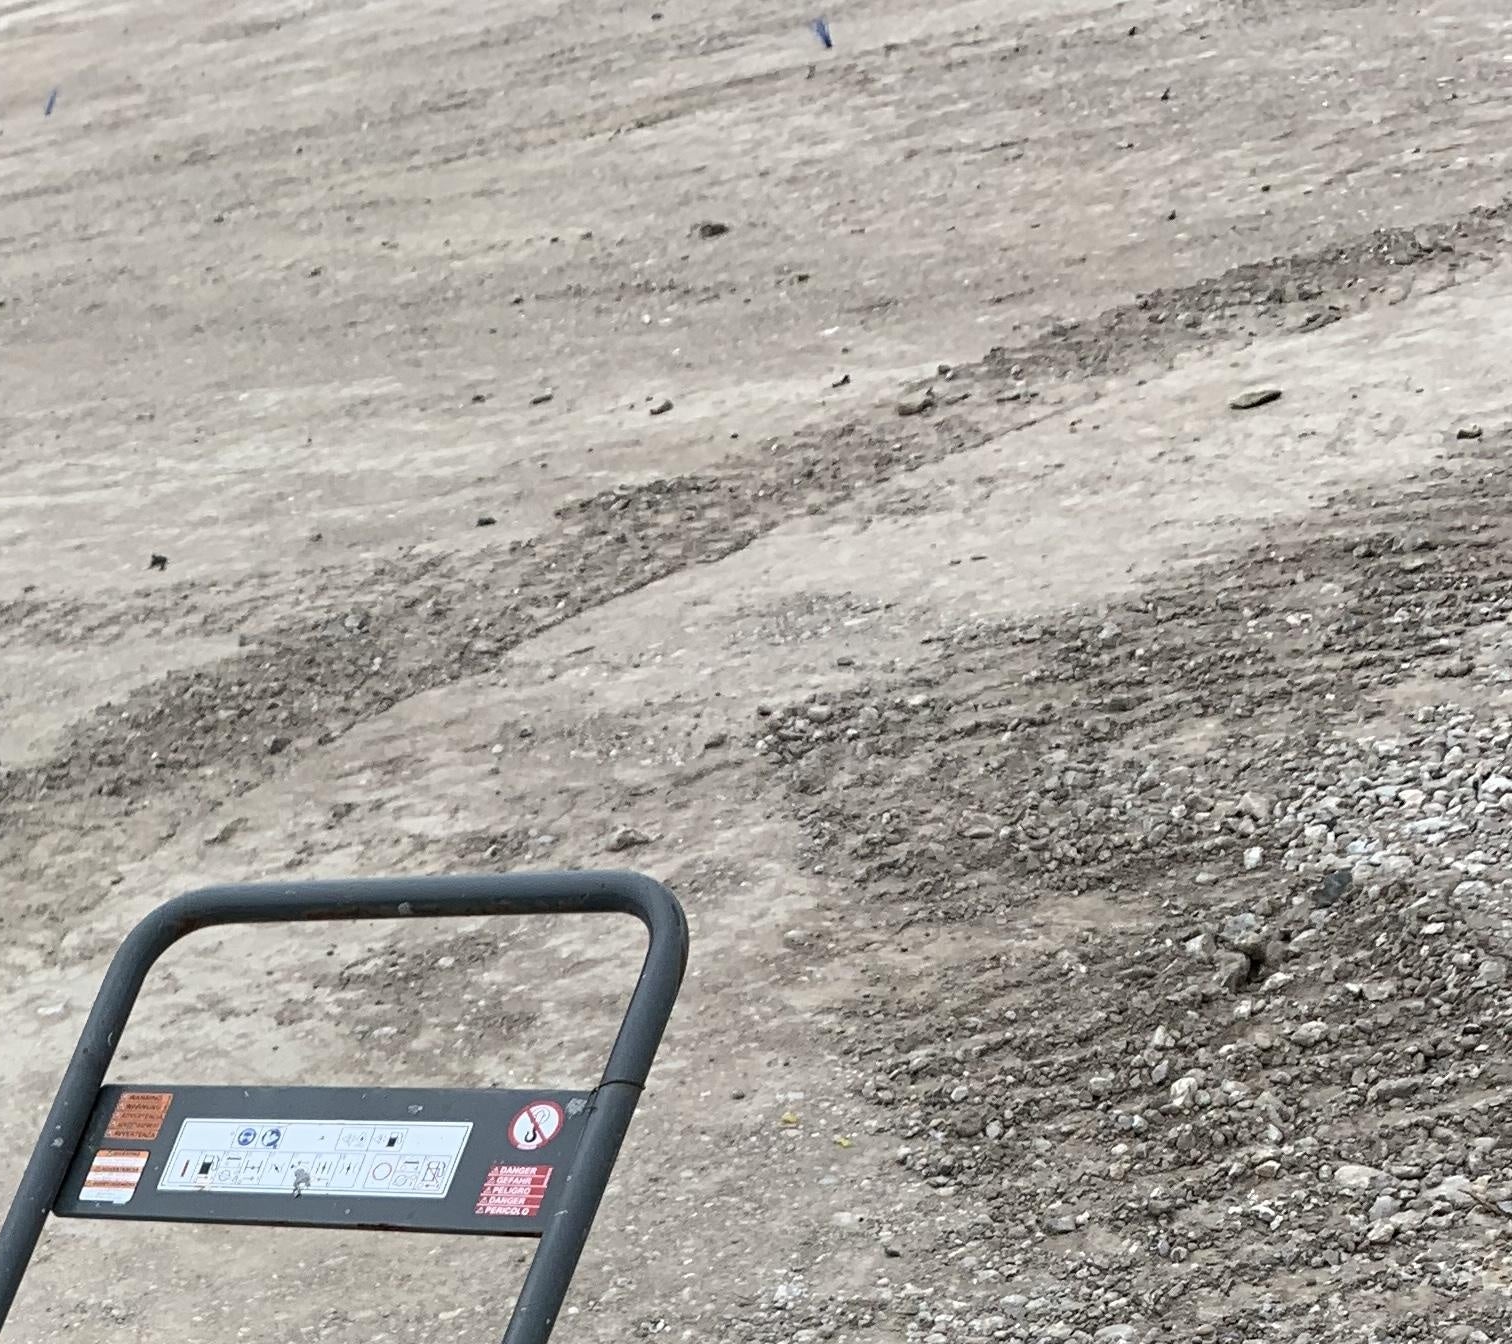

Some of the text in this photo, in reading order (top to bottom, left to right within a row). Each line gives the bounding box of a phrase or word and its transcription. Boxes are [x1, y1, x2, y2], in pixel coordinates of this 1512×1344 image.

[499, 1166, 538, 1175] DANGER
[496, 1176, 533, 1185] GEFAHR
[492, 1186, 532, 1195] PELIGRO
[488, 1196, 527, 1205] DANGER
[484, 1206, 530, 1216] PERICOLO
